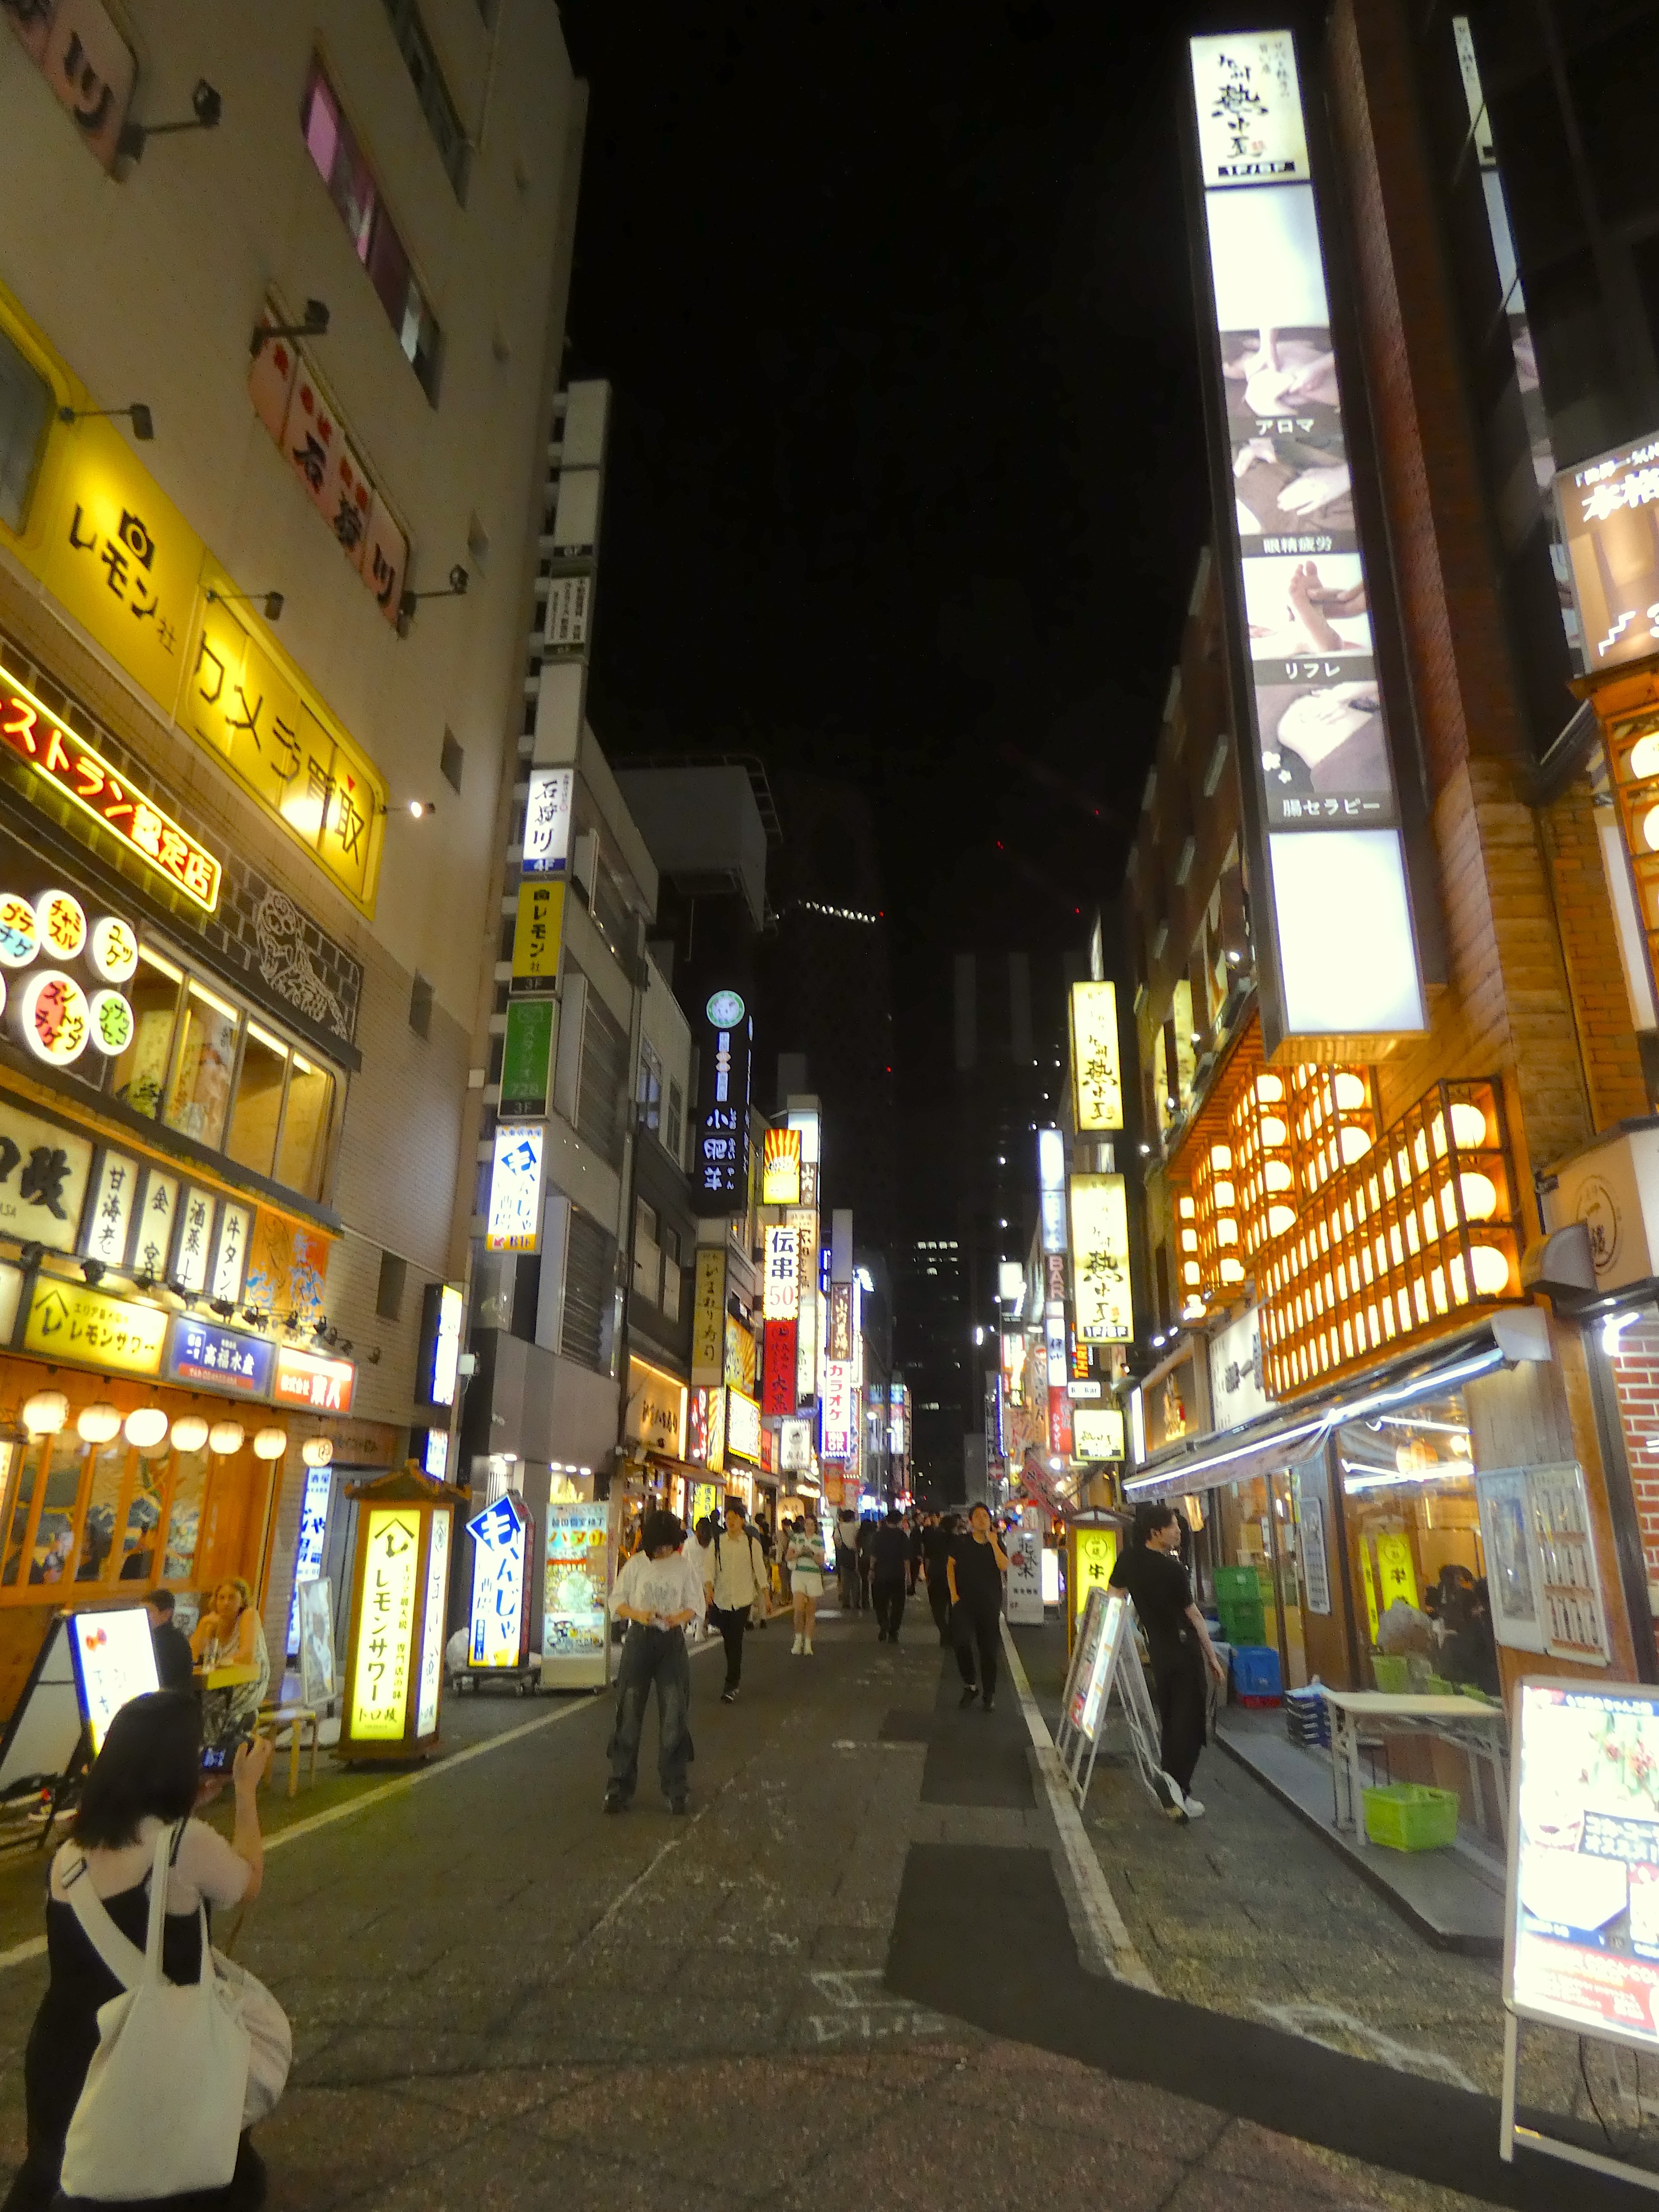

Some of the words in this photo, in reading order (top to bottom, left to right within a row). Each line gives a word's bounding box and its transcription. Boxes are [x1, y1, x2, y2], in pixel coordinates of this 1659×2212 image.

[1256, 418, 1314, 435] アロマ
[69, 504, 175, 656] レモン社
[1286, 663, 1340, 679] リフレ
[193, 631, 365, 866] カメラ買取
[535, 780, 558, 852] 石狩川
[1284, 798, 1380, 817] 腸セラピー
[534, 859, 555, 871] 4F
[530, 905, 548, 972] レモン社
[98, 1165, 126, 1255] 甘海老
[772, 1231, 794, 1279] 伝串
[1049, 1255, 1064, 1300] BAR
[770, 1285, 794, 1305] 50
[70, 1320, 155, 1353] レモンサワー
[830, 1365, 843, 1420] カラオケ
[828, 1442, 844, 1451] OK
[367, 1570, 390, 1701] レモンサワー
